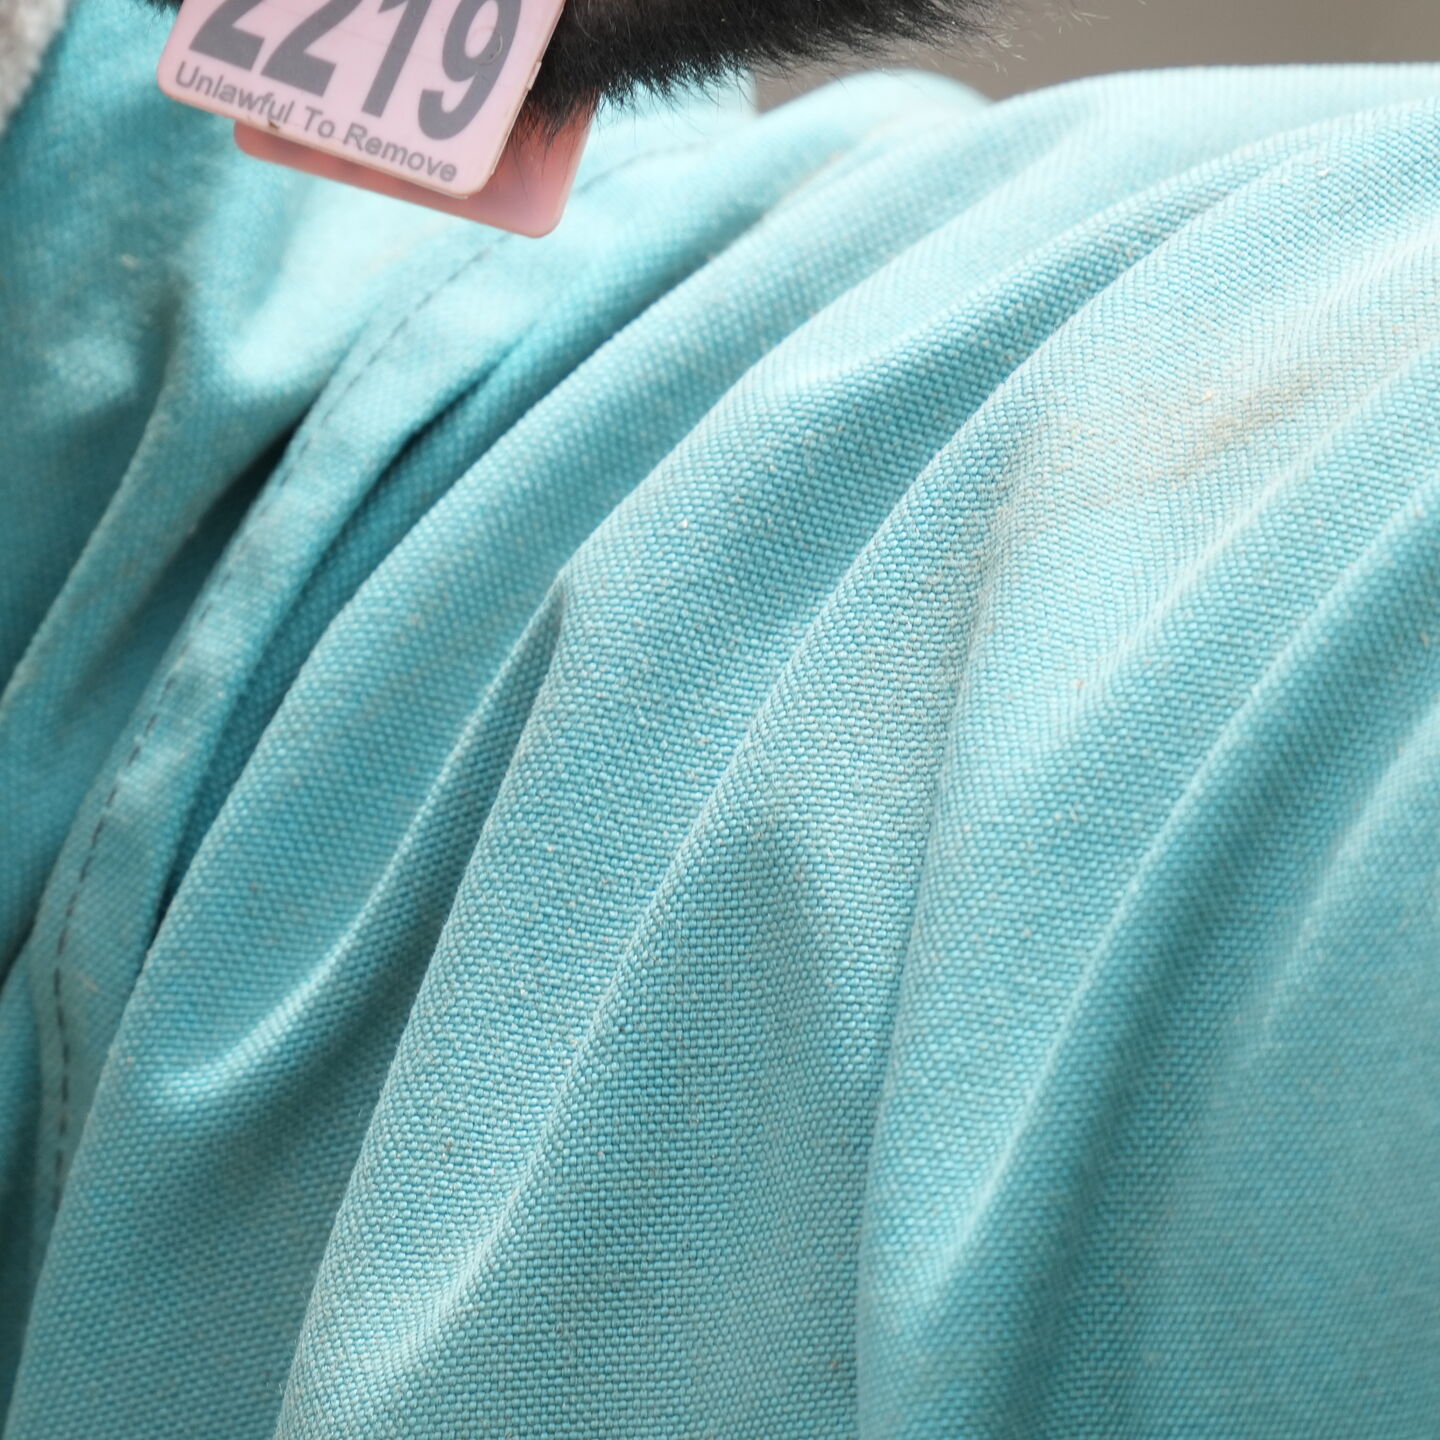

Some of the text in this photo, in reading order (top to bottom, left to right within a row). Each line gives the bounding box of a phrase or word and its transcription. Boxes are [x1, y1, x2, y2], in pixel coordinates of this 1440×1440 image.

[175, 62, 457, 183] Unlawful To Remove
